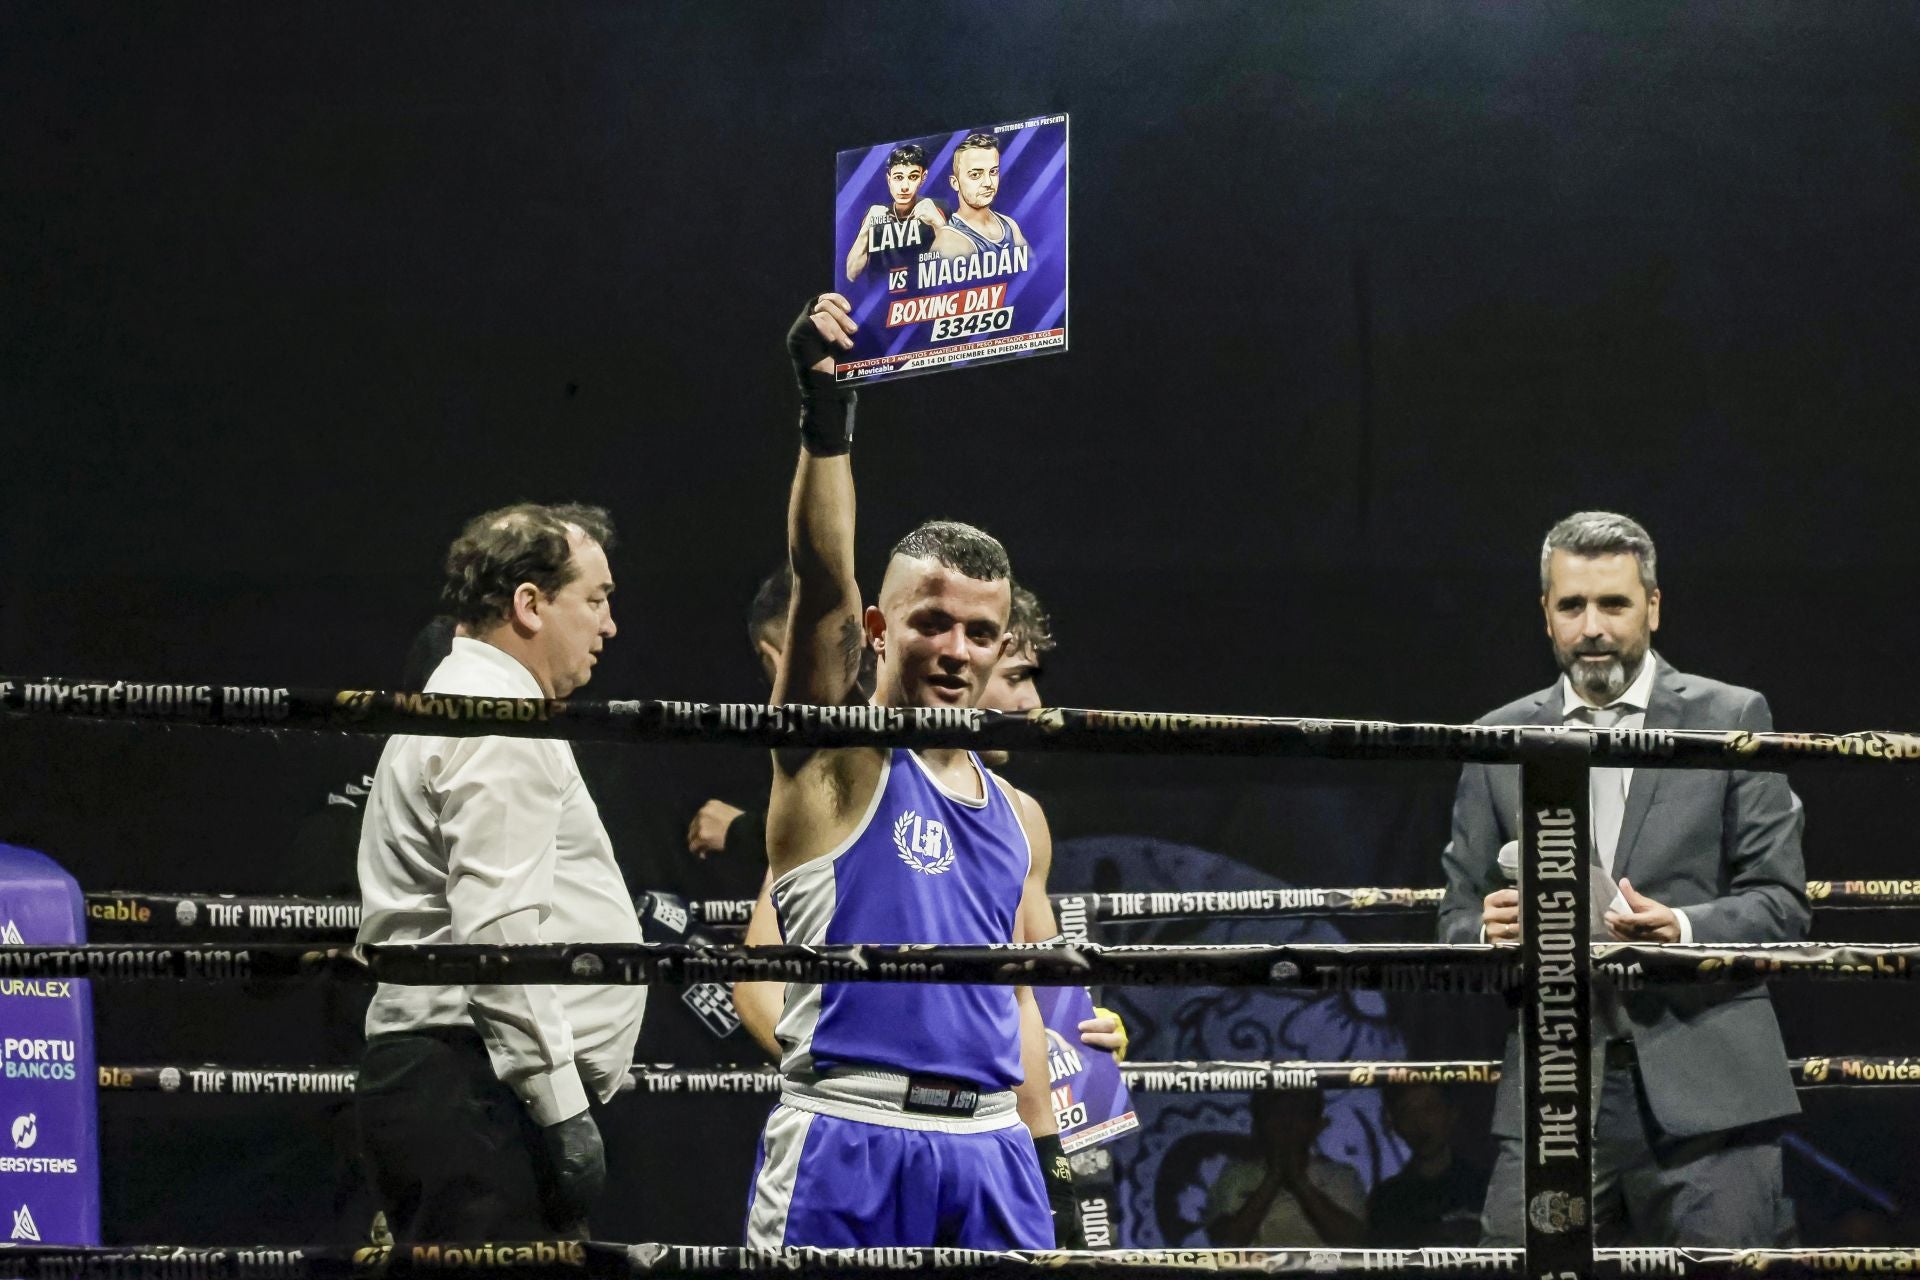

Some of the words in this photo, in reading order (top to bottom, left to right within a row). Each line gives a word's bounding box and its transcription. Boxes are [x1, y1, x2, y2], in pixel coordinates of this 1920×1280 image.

[869, 220, 921, 253] LAYA
[888, 270, 908, 290] VS
[918, 243, 1028, 289] MAGADÁN
[919, 252, 941, 263] BORJA
[889, 293, 960, 326] BOXING
[964, 286, 1004, 312] DAY
[936, 310, 1009, 340] 33450
[853, 360, 880, 369] ASALTOS
[897, 352, 927, 361] MINUTOS
[928, 347, 957, 356] AMATEUR
[911, 359, 925, 367] SAB
[927, 357, 935, 365] 14
[948, 350, 985, 361] DICIEMBRE
[987, 347, 996, 355] EN
[998, 342, 1028, 353] PIEDRAS
[1029, 337, 1062, 348] BLANCAS
[857, 364, 894, 376] Movicable
[719, 703, 903, 733] MYSTERIOUS
[914, 706, 984, 733] RING
[1536, 808, 1578, 881] RING
[206, 903, 244, 927] THE
[1109, 893, 1147, 916] THE
[1150, 890, 1275, 914] MYSTERIOUS
[1279, 888, 1325, 910] RING
[1537, 890, 1579, 1095] MYSTERIOUS
[5, 1038, 75, 1061] PORTU
[6, 1061, 76, 1079] BANCOS
[190, 1071, 225, 1092] THE
[231, 1071, 357, 1093] MYSTERIOUS
[1144, 1070, 1268, 1092] MYSTERIOUS
[1272, 1069, 1318, 1090] RING
[1538, 1103, 1579, 1165] THE
[0, 1156, 78, 1174] ERSYSTEMS
[1081, 1198, 1111, 1247] RING
